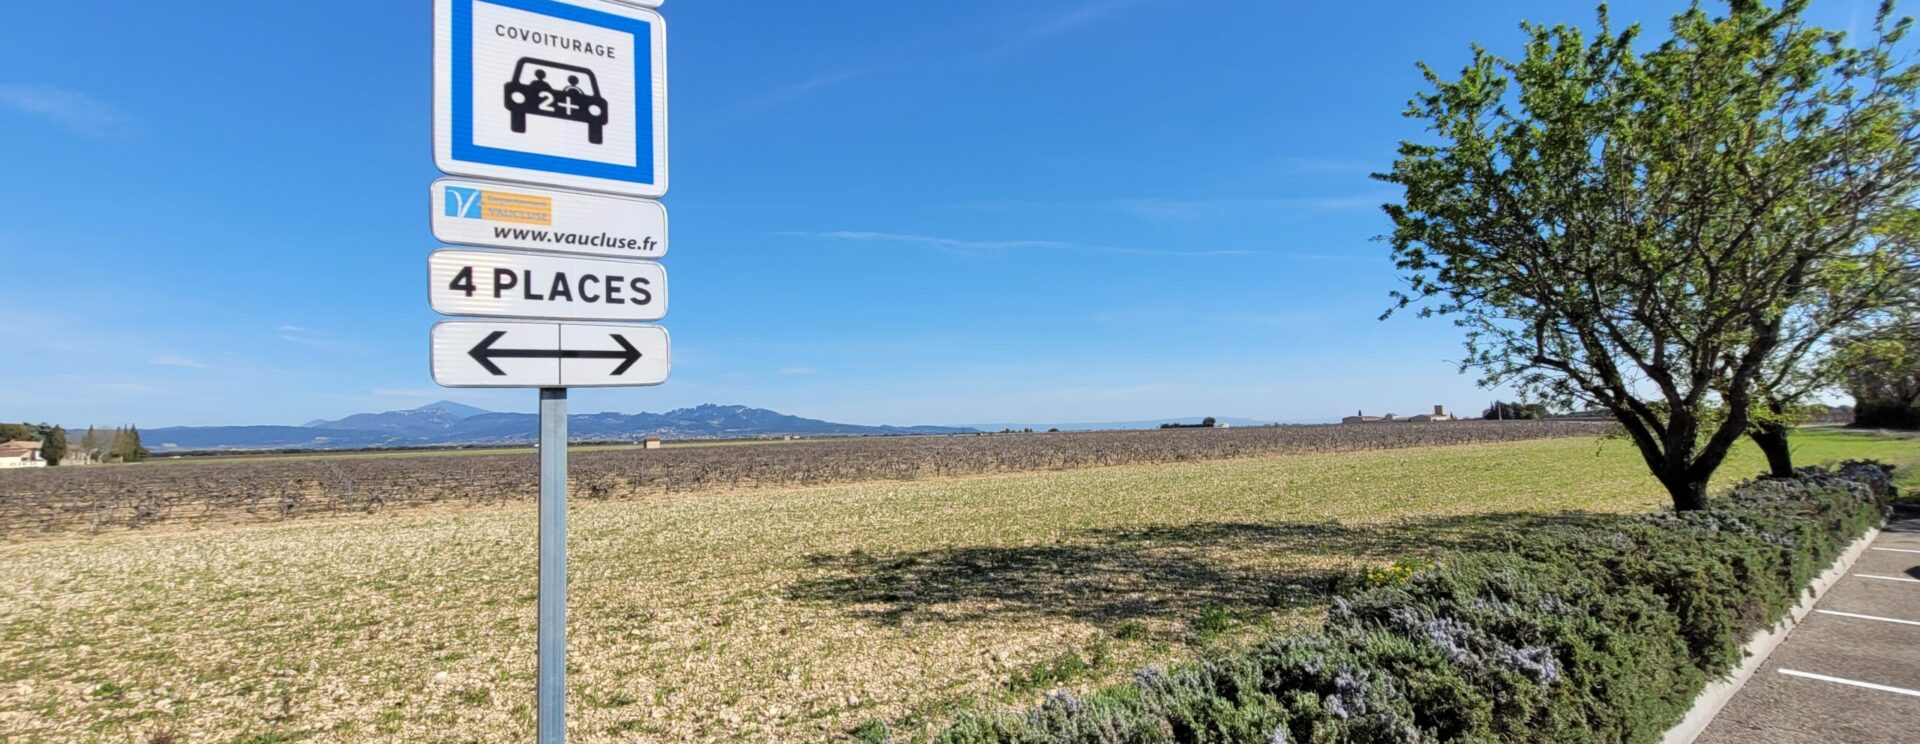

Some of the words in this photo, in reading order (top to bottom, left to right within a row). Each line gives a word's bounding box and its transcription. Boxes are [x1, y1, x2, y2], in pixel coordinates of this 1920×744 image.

[495, 24, 616, 59] COVOITURAGE
[494, 226, 658, 251] www.vaucluse.fr
[449, 266, 477, 297] 4
[493, 267, 652, 306] PLACES
